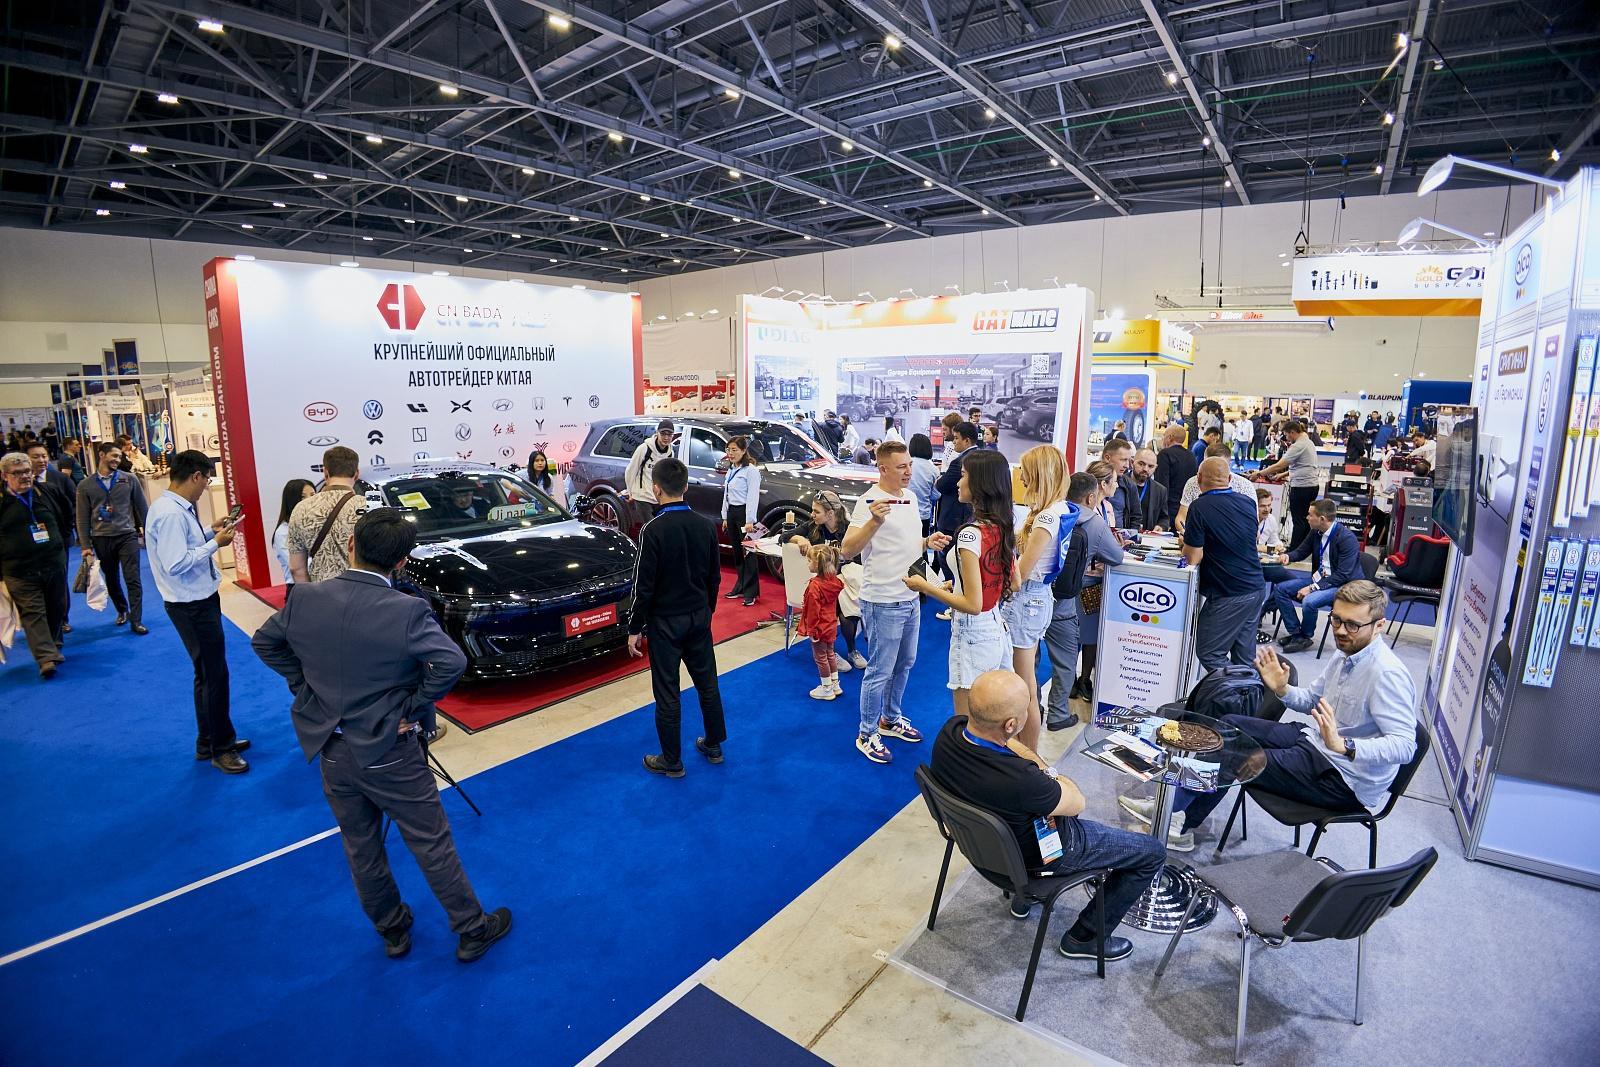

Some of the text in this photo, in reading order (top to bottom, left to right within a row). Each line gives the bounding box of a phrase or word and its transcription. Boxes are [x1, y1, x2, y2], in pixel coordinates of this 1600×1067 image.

[437, 304, 457, 317] CN
[463, 305, 502, 319] BADA
[374, 341, 556, 362] КРУПНЕЙШИЙ ОФИЦИАЛЬНЫЙ
[408, 367, 532, 388] АВТОТРЕЙДЕР КИТАЯ
[887, 368, 908, 377] Garage
[909, 368, 940, 378] Equipment
[966, 367, 994, 377] Solution
[308, 408, 336, 417] BYD
[213, 346, 236, 505] WWW.BADA-CAR.COM
[1123, 587, 1170, 607] alca
[1122, 645, 1163, 658] Таджикистан
[1123, 655, 1160, 667] Узбекистан
